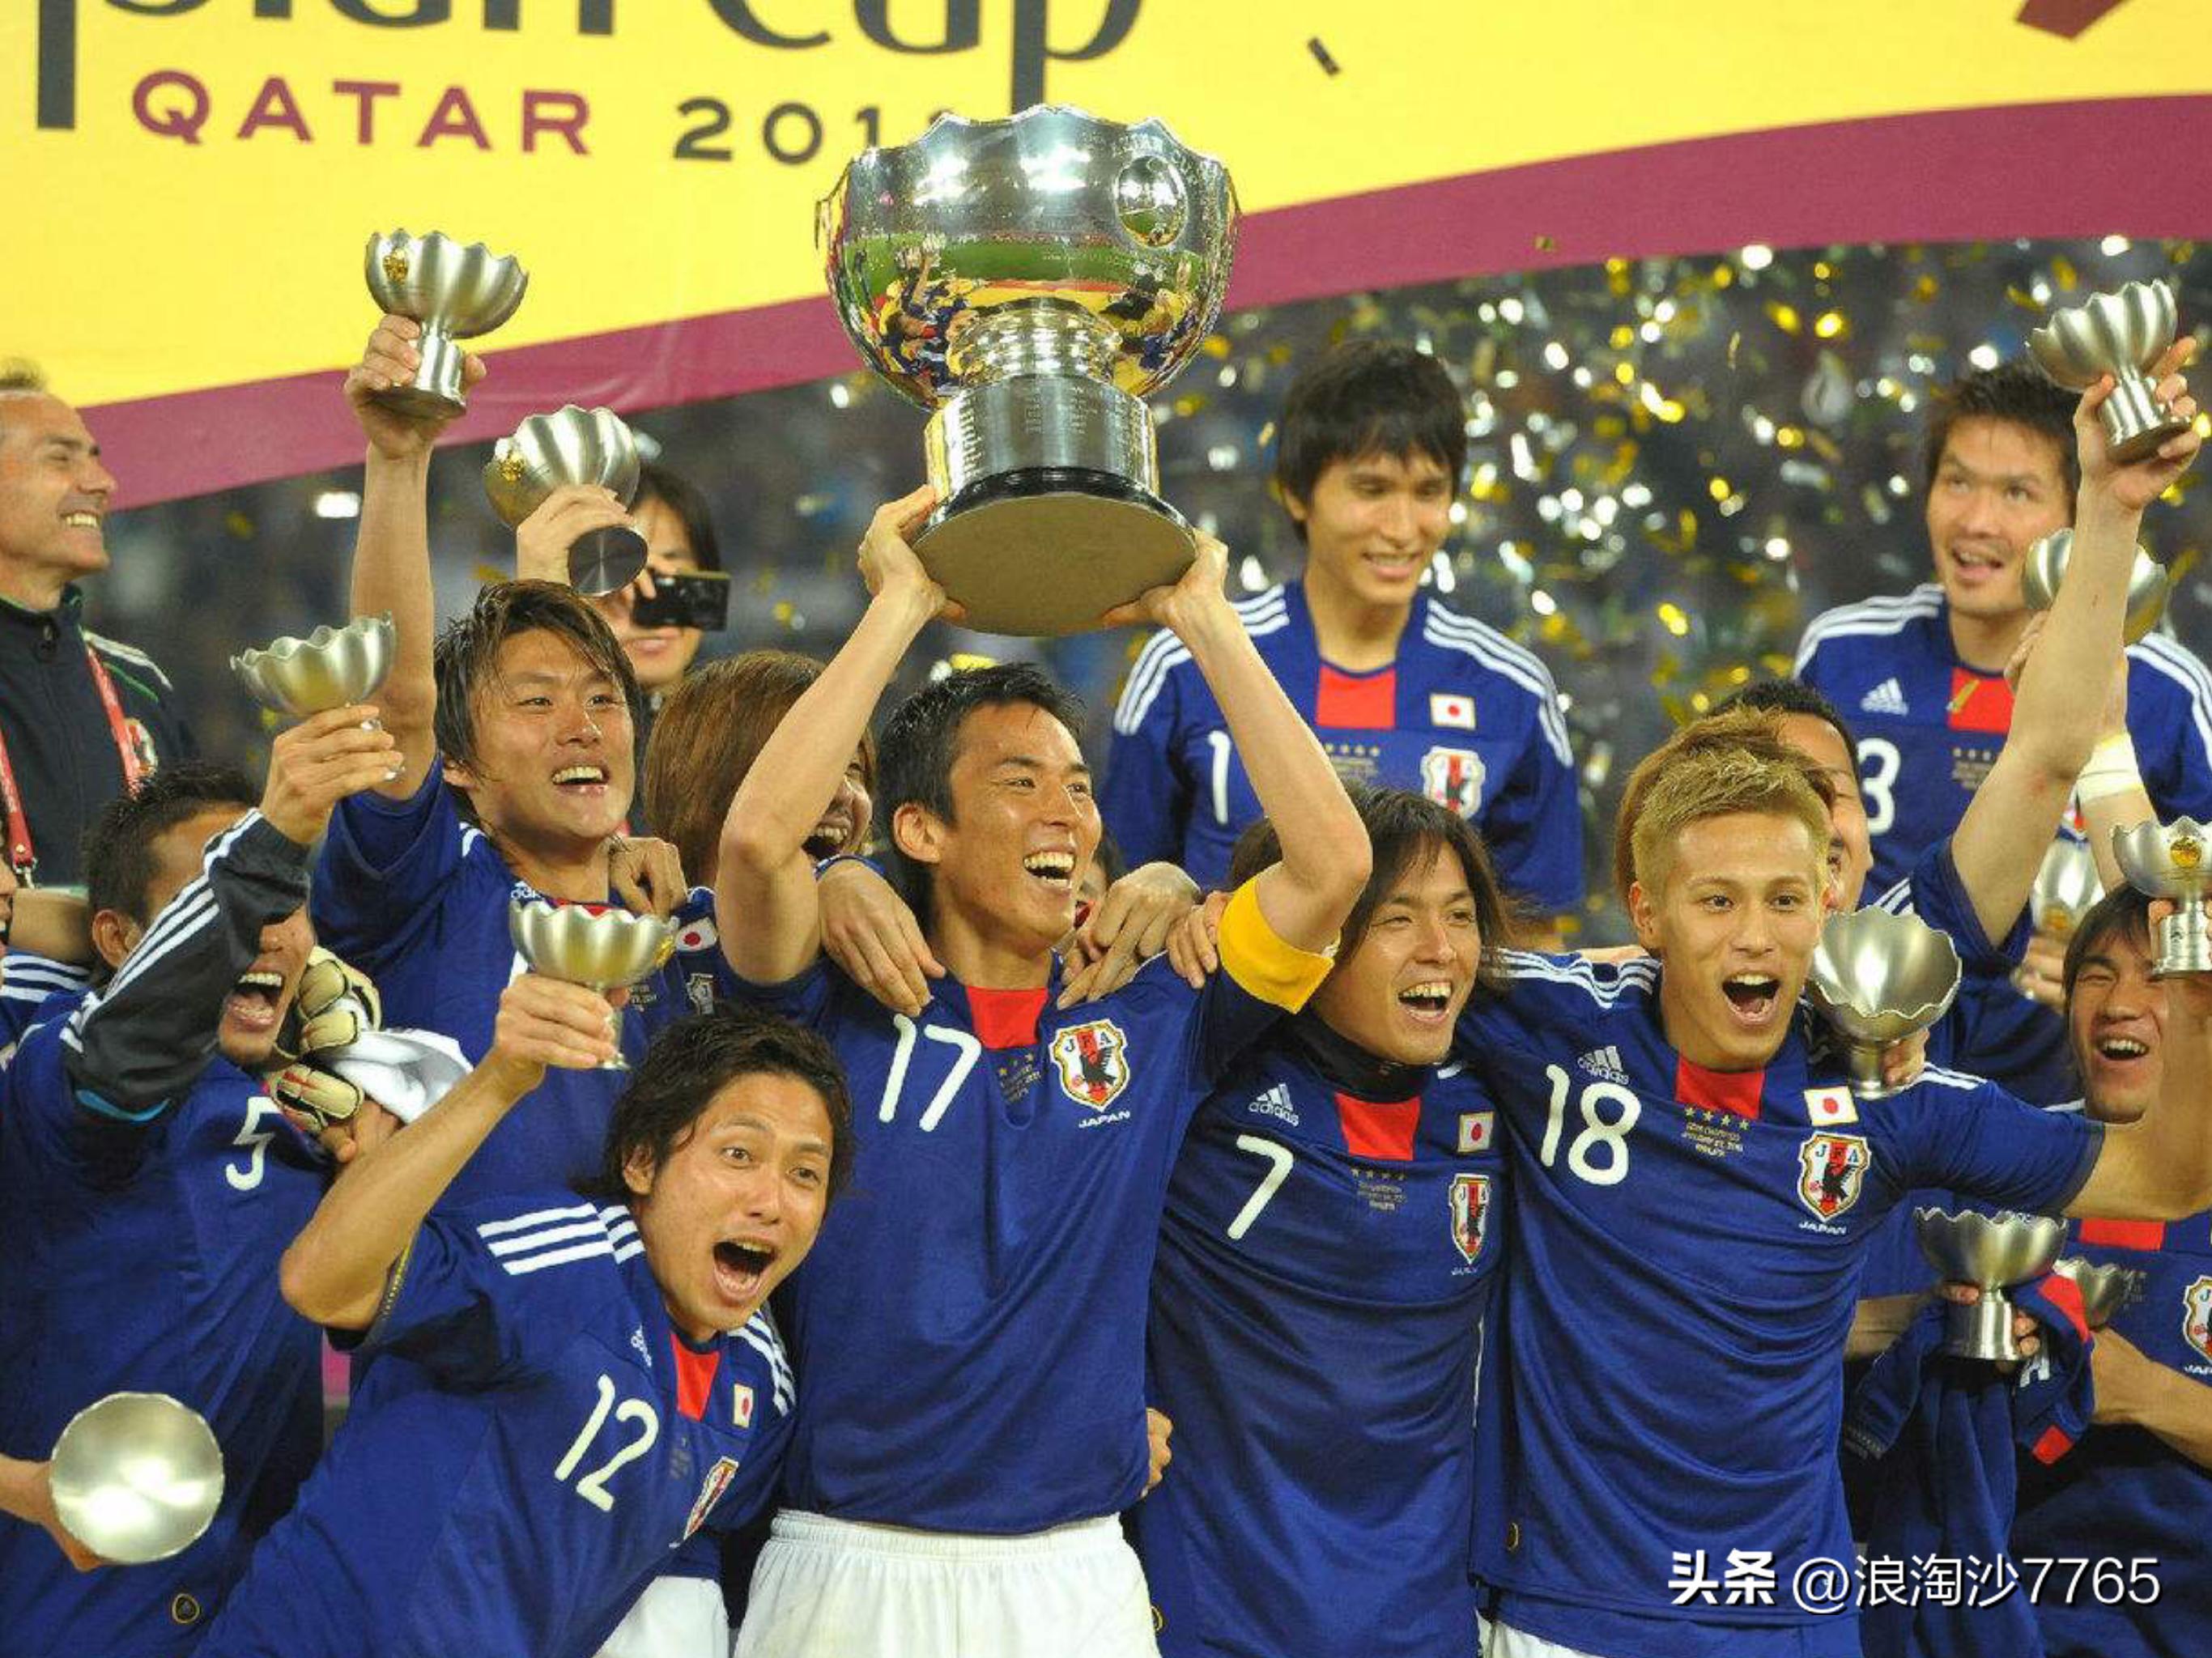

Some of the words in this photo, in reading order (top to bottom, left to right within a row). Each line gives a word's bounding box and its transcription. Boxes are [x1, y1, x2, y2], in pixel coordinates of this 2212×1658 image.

[132, 70, 591, 155] QATAR
[673, 96, 955, 166] 201
[878, 1013, 982, 1133] 17
[1078, 1110, 1131, 1129] JAPAN
[1248, 1101, 1300, 1128] adidas
[225, 1096, 282, 1191] 5
[1540, 1063, 1642, 1186] 18
[1227, 1134, 1295, 1239] 7
[554, 1373, 660, 1512] 12
